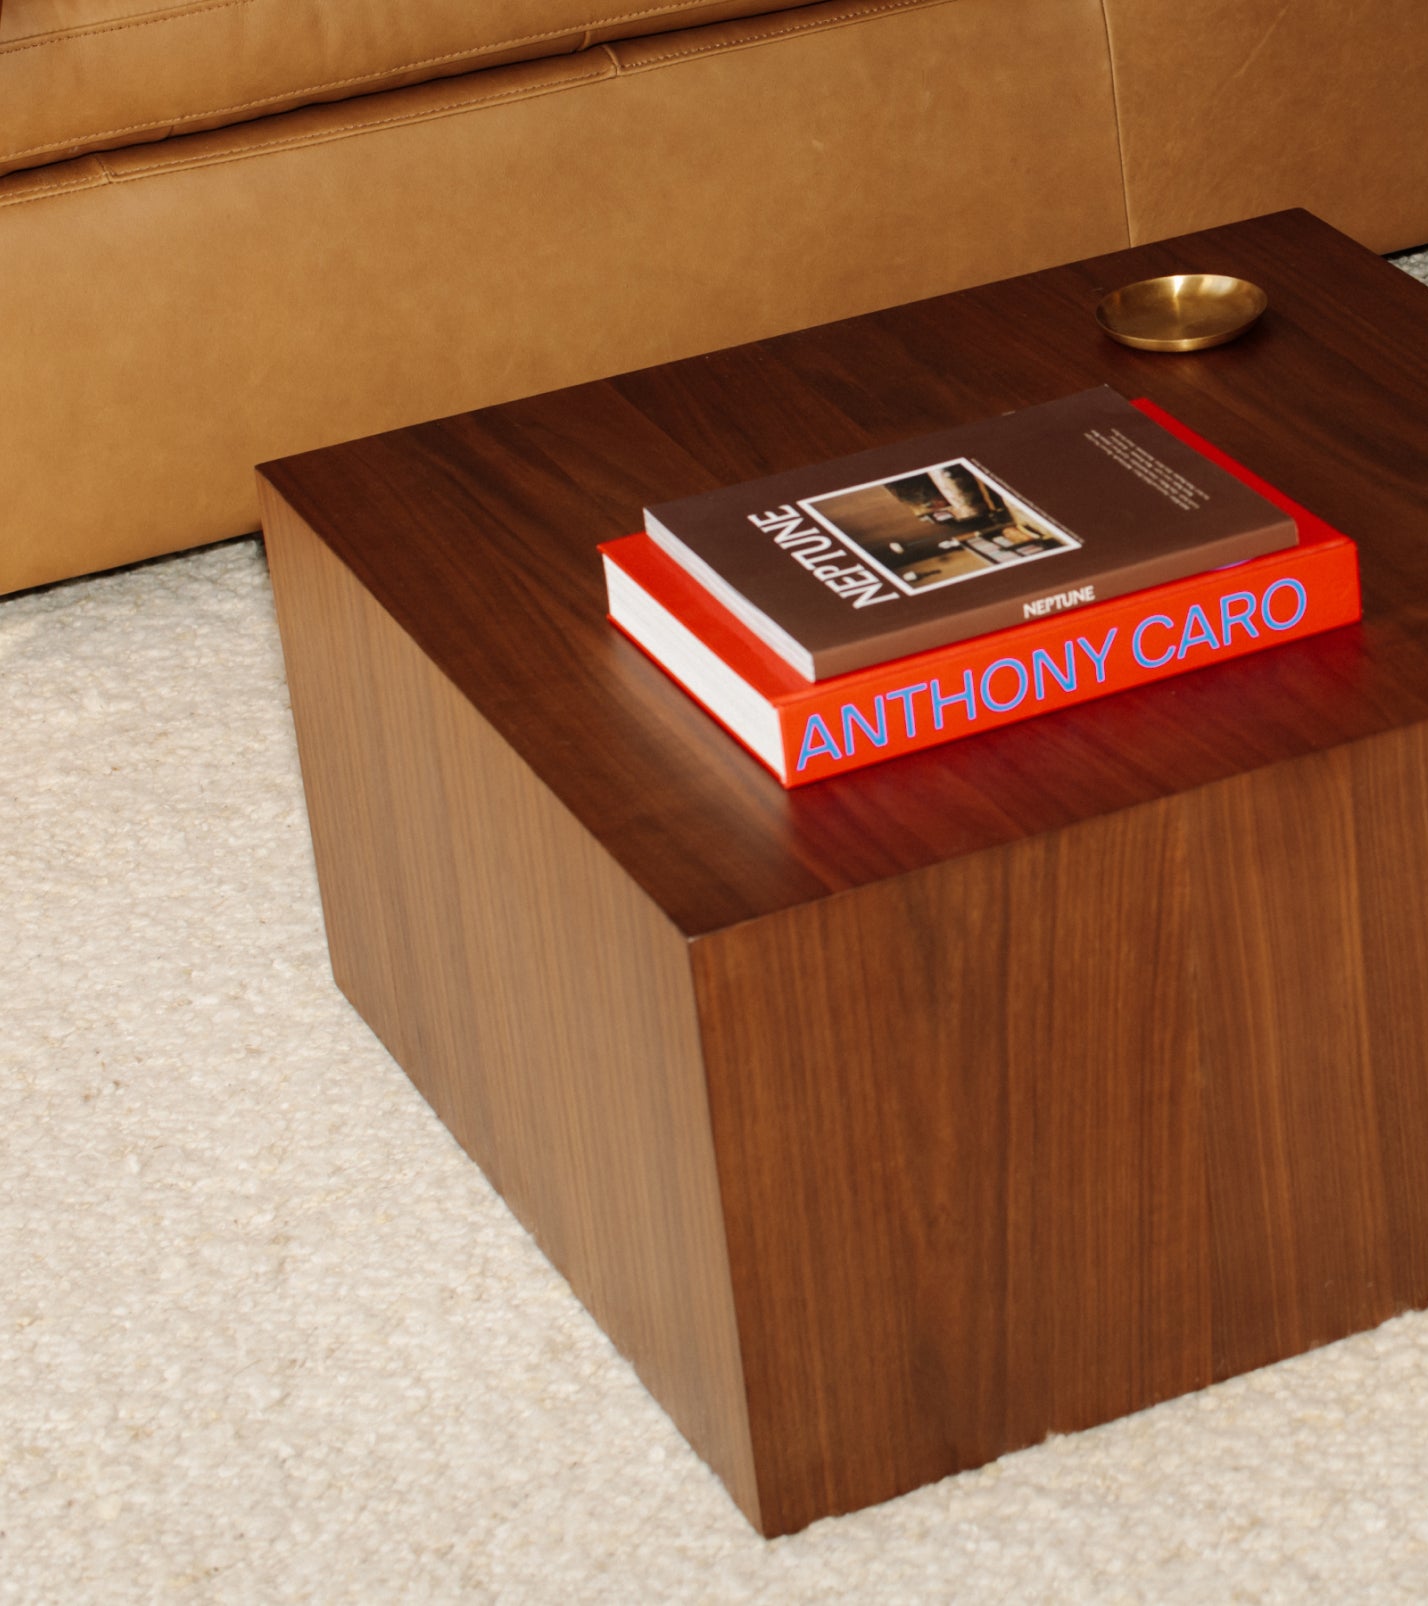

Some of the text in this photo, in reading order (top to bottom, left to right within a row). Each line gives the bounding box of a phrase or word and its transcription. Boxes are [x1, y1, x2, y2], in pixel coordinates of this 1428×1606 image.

[747, 504, 900, 609] NEPTUNE
[1023, 585, 1096, 619] NEPTUNE
[796, 577, 1308, 771] ANTHONY CARO
